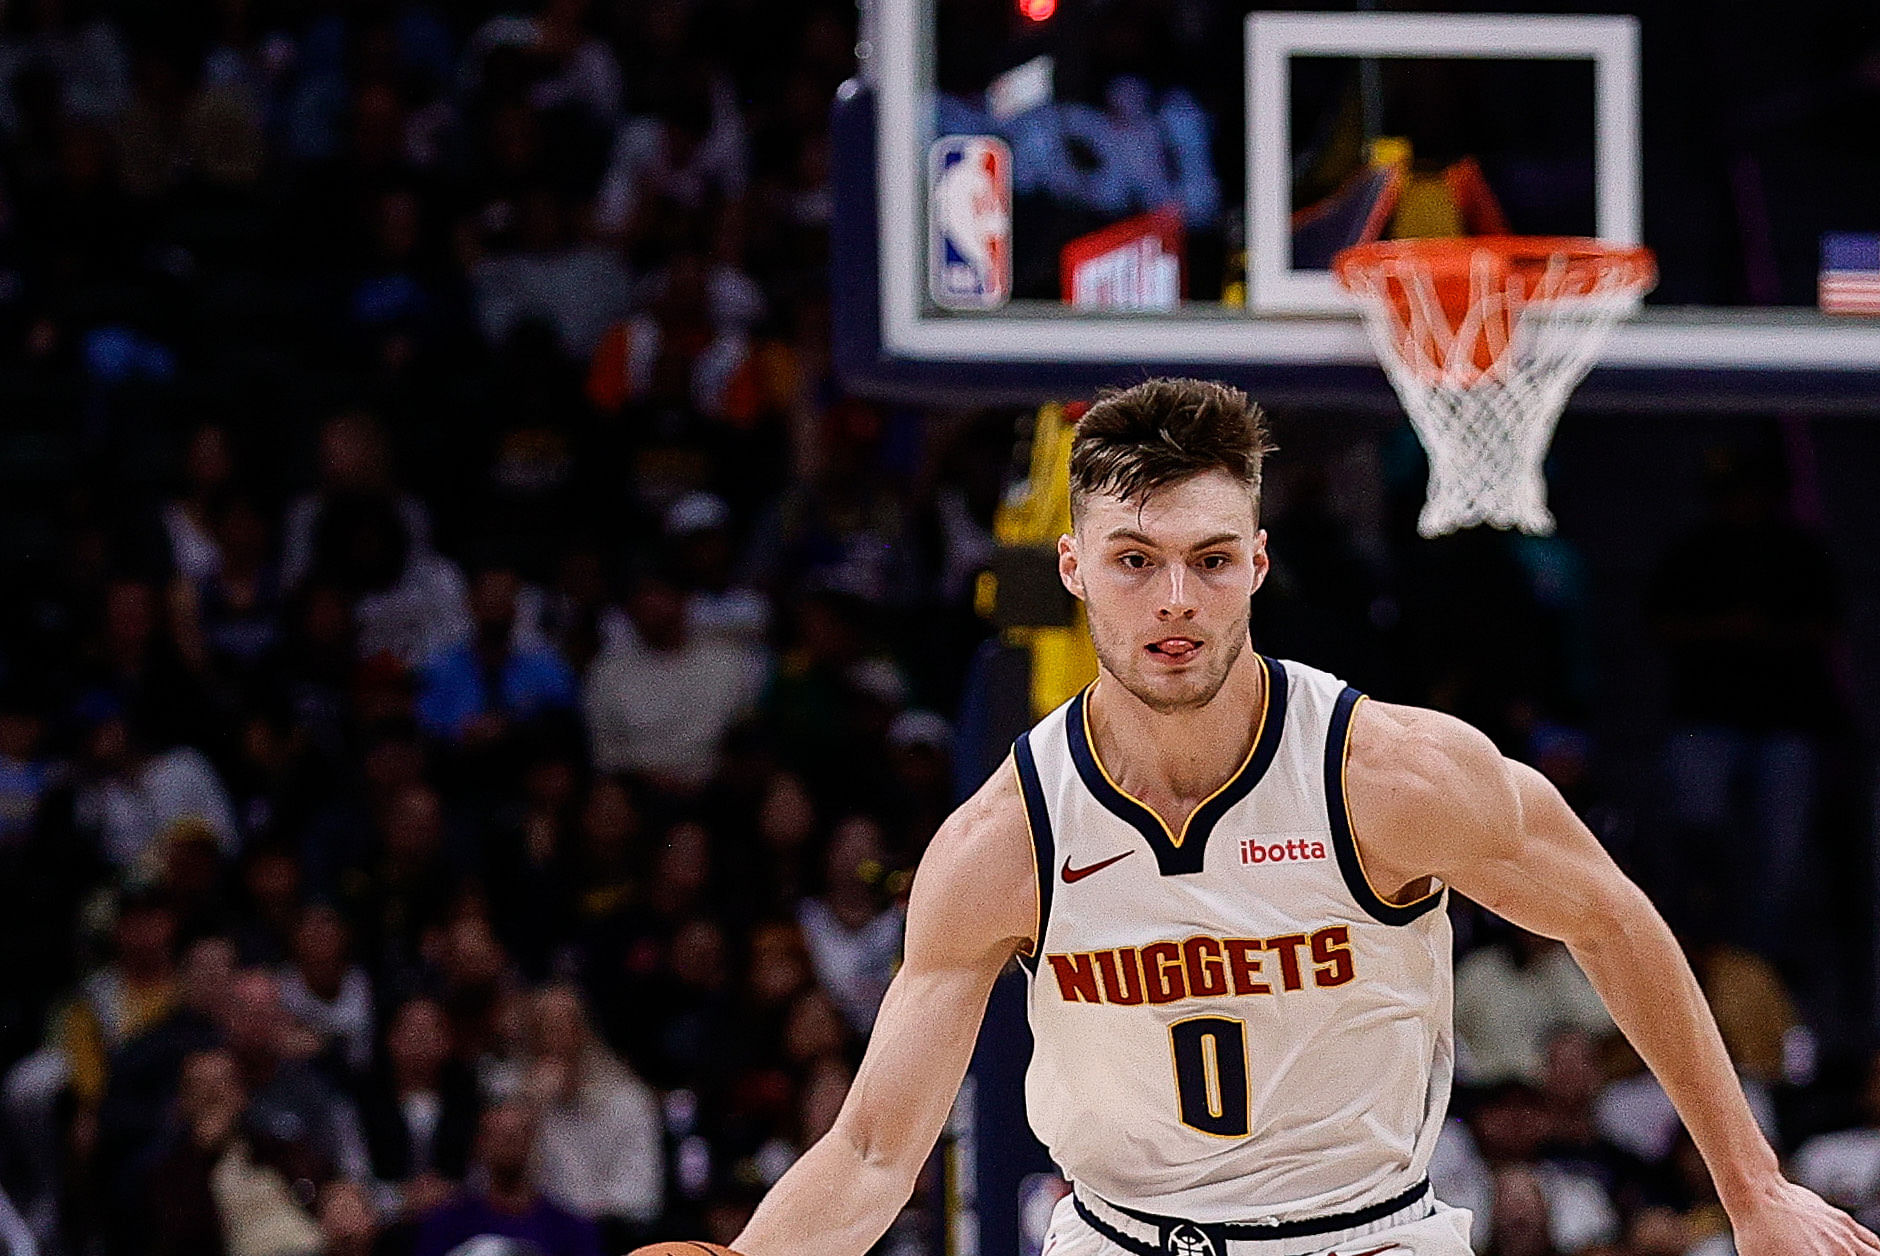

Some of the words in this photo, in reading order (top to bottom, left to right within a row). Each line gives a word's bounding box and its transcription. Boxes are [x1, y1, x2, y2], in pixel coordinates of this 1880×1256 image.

[1239, 838, 1327, 865] ibotta
[1045, 924, 1356, 1006] NUGGETS
[1167, 1013, 1252, 1139] 0
